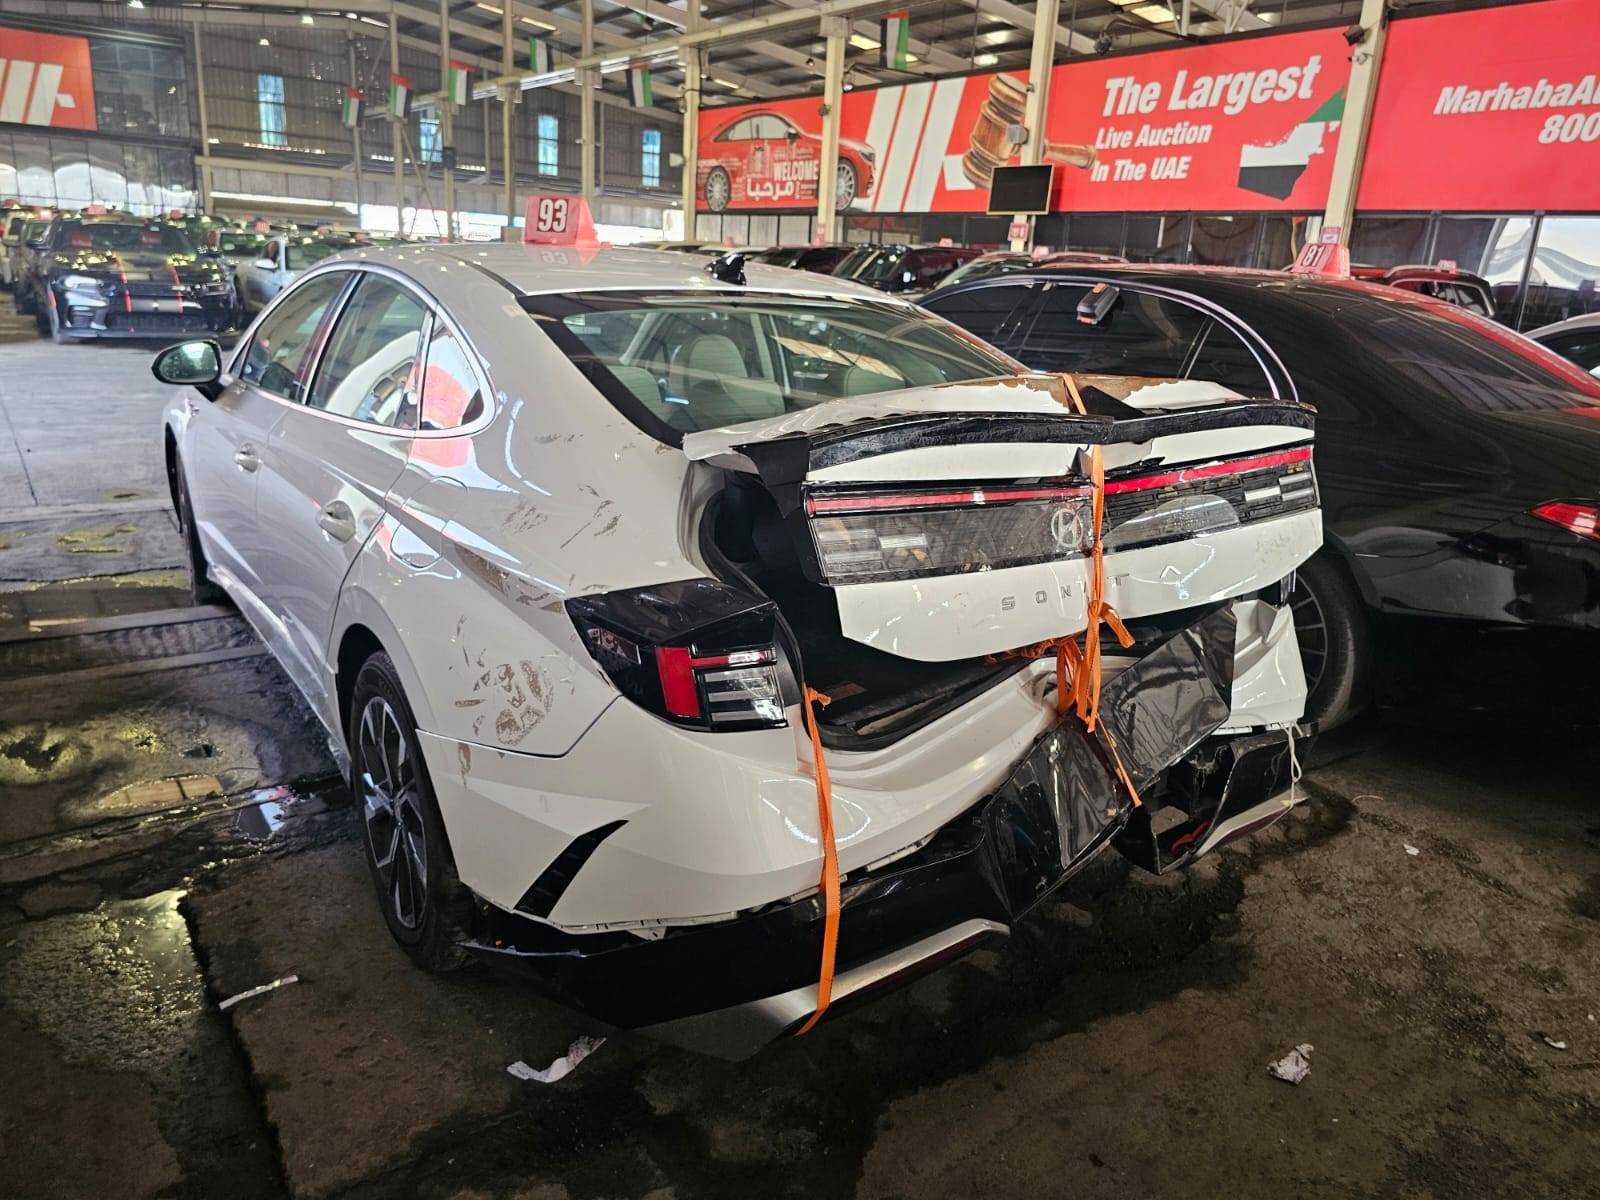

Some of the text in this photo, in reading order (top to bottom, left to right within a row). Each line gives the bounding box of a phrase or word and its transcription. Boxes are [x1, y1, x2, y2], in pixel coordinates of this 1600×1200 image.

[1102, 55, 1322, 117] The Largest
[1095, 121, 1213, 150] Live Auction
[1538, 112, 1600, 144] 800
[773, 159, 819, 182] WELCOME
[1090, 156, 1193, 182] In The UAE
[747, 177, 795, 201] مرحبا
[538, 198, 568, 232] 93
